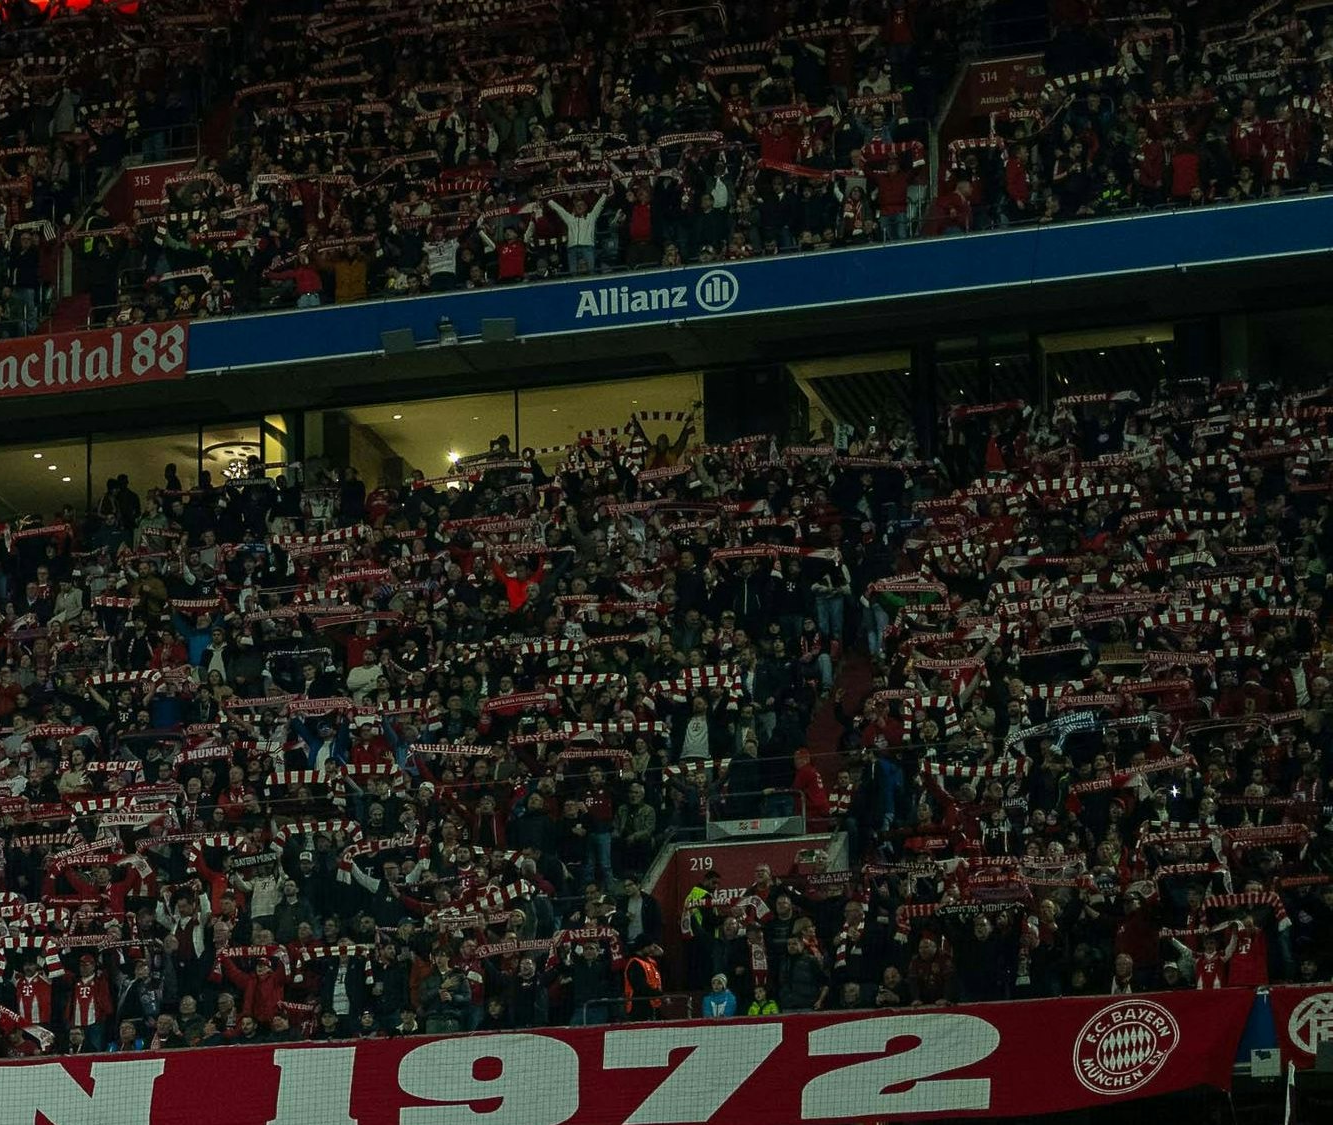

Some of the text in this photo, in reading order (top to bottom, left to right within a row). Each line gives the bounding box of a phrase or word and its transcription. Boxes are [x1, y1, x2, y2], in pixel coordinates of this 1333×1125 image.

[134, 176, 151, 187] 315
[576, 283, 688, 319] Allianz
[132, 323, 186, 376] 83
[690, 857, 713, 871] 219
[1085, 1008, 1170, 1044] F.C. BAYERN
[1081, 1057, 1144, 1087] MÜNCHEN
